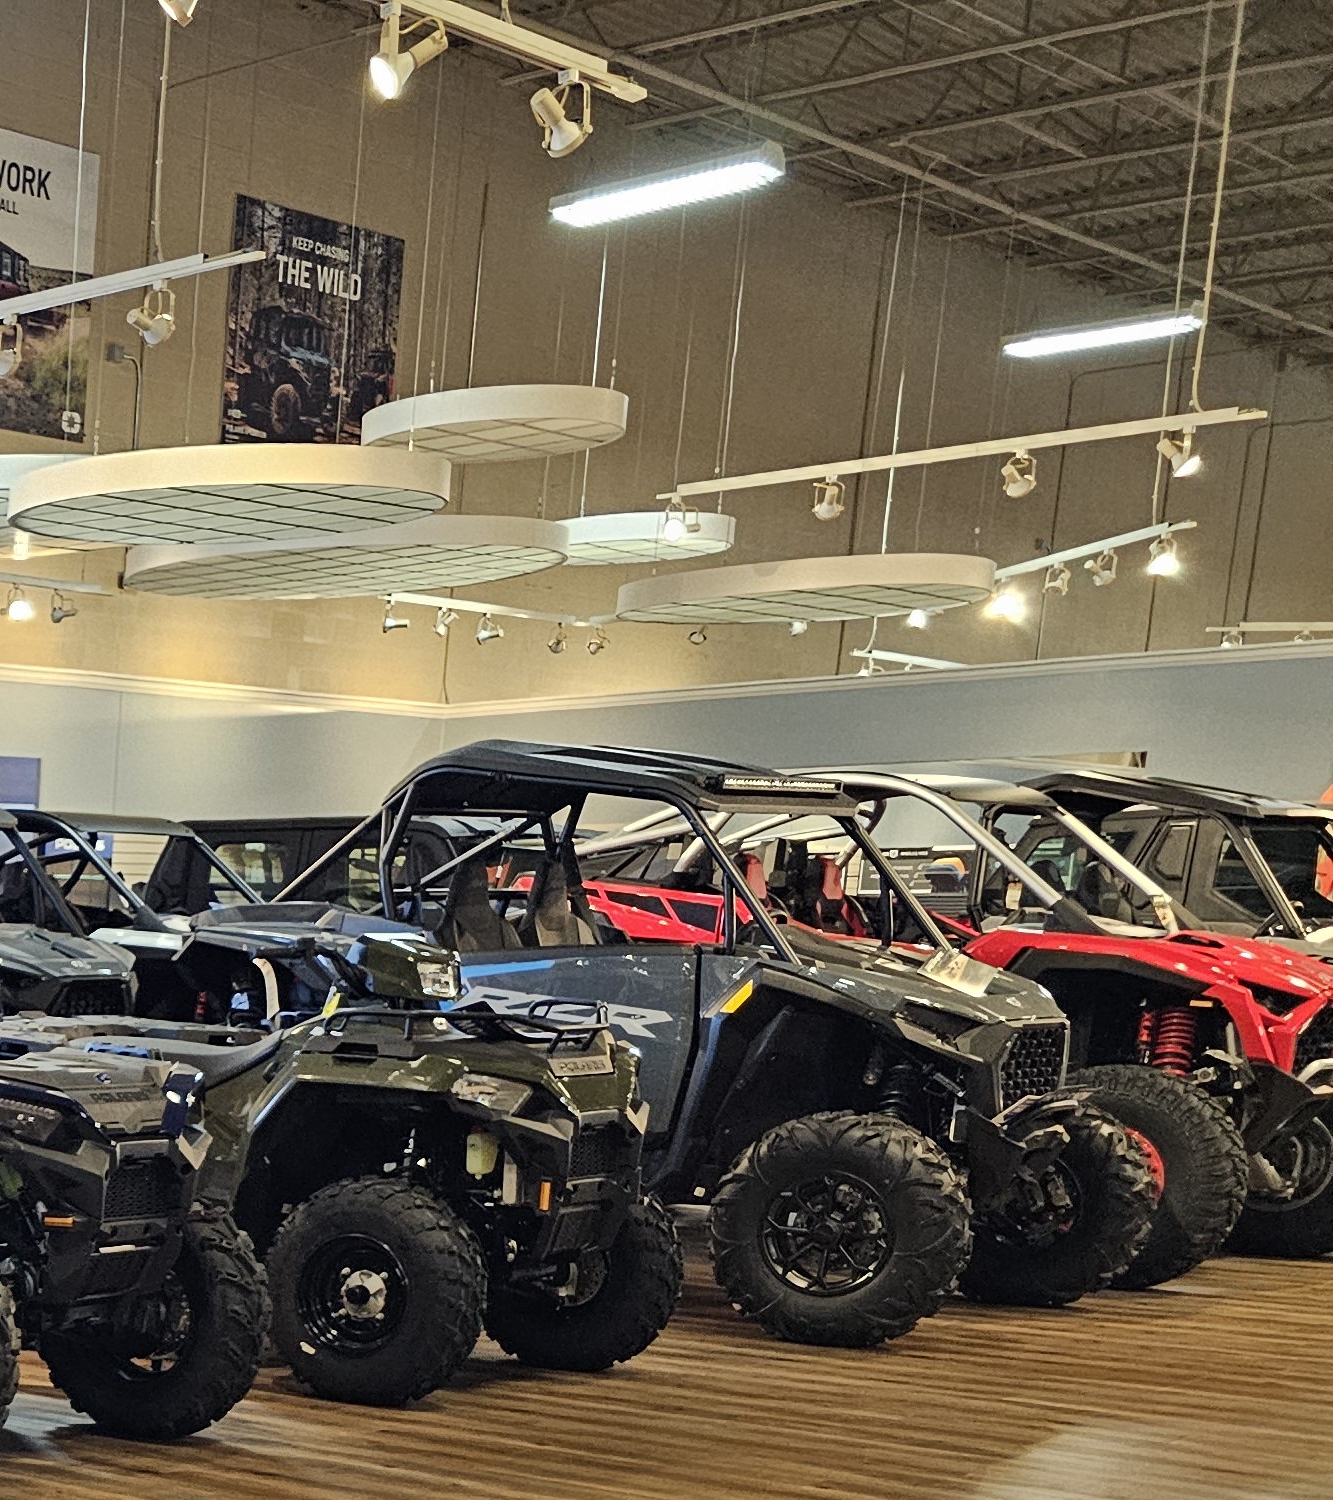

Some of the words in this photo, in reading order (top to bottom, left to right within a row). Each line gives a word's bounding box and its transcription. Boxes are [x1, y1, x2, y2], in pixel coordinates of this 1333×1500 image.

[0, 198, 19, 215] ALL
[293, 236, 314, 252] KEEP
[276, 254, 312, 289] THE
[317, 264, 361, 300] WILD
